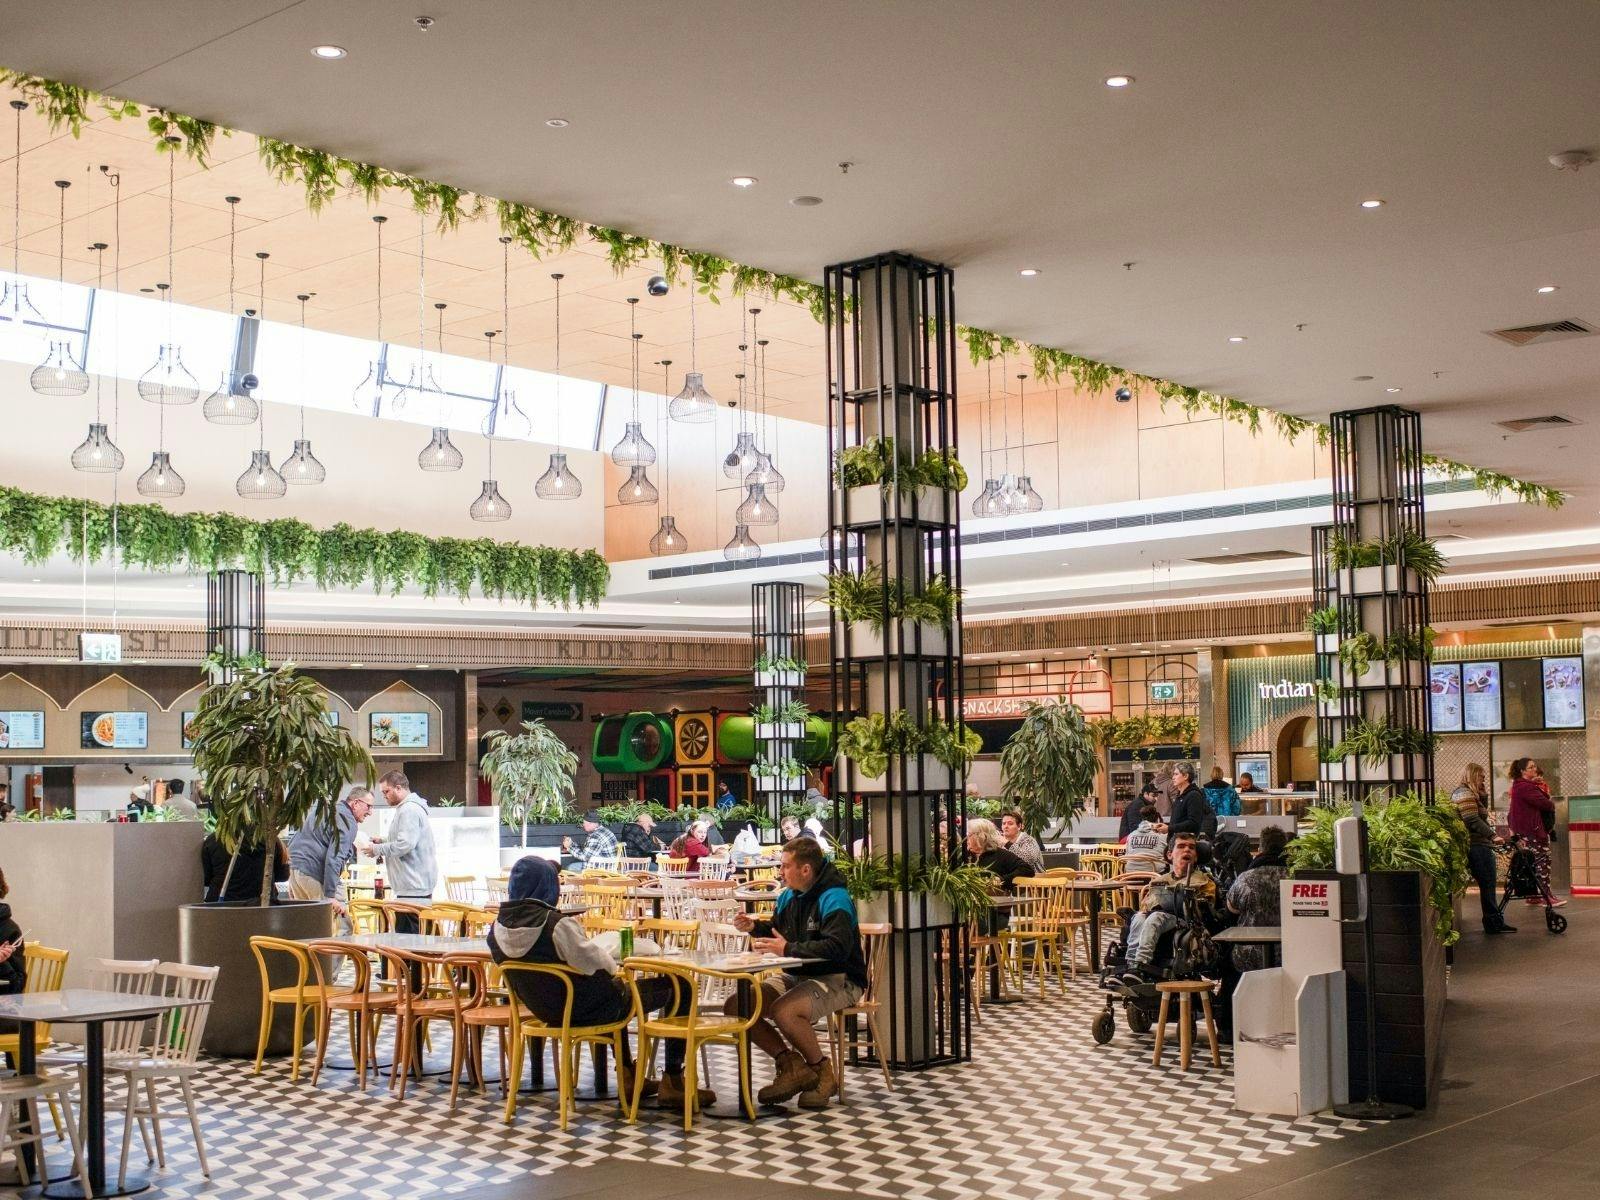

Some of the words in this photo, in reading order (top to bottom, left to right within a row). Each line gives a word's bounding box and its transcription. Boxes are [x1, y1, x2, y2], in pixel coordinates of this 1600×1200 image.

[0, 627, 170, 652] TURSH
[557, 640, 633, 660] KIDS
[649, 642, 713, 662] CITY
[1259, 679, 1315, 698] indian
[605, 791, 628, 800] ENTRY
[1292, 884, 1328, 898] FREE
